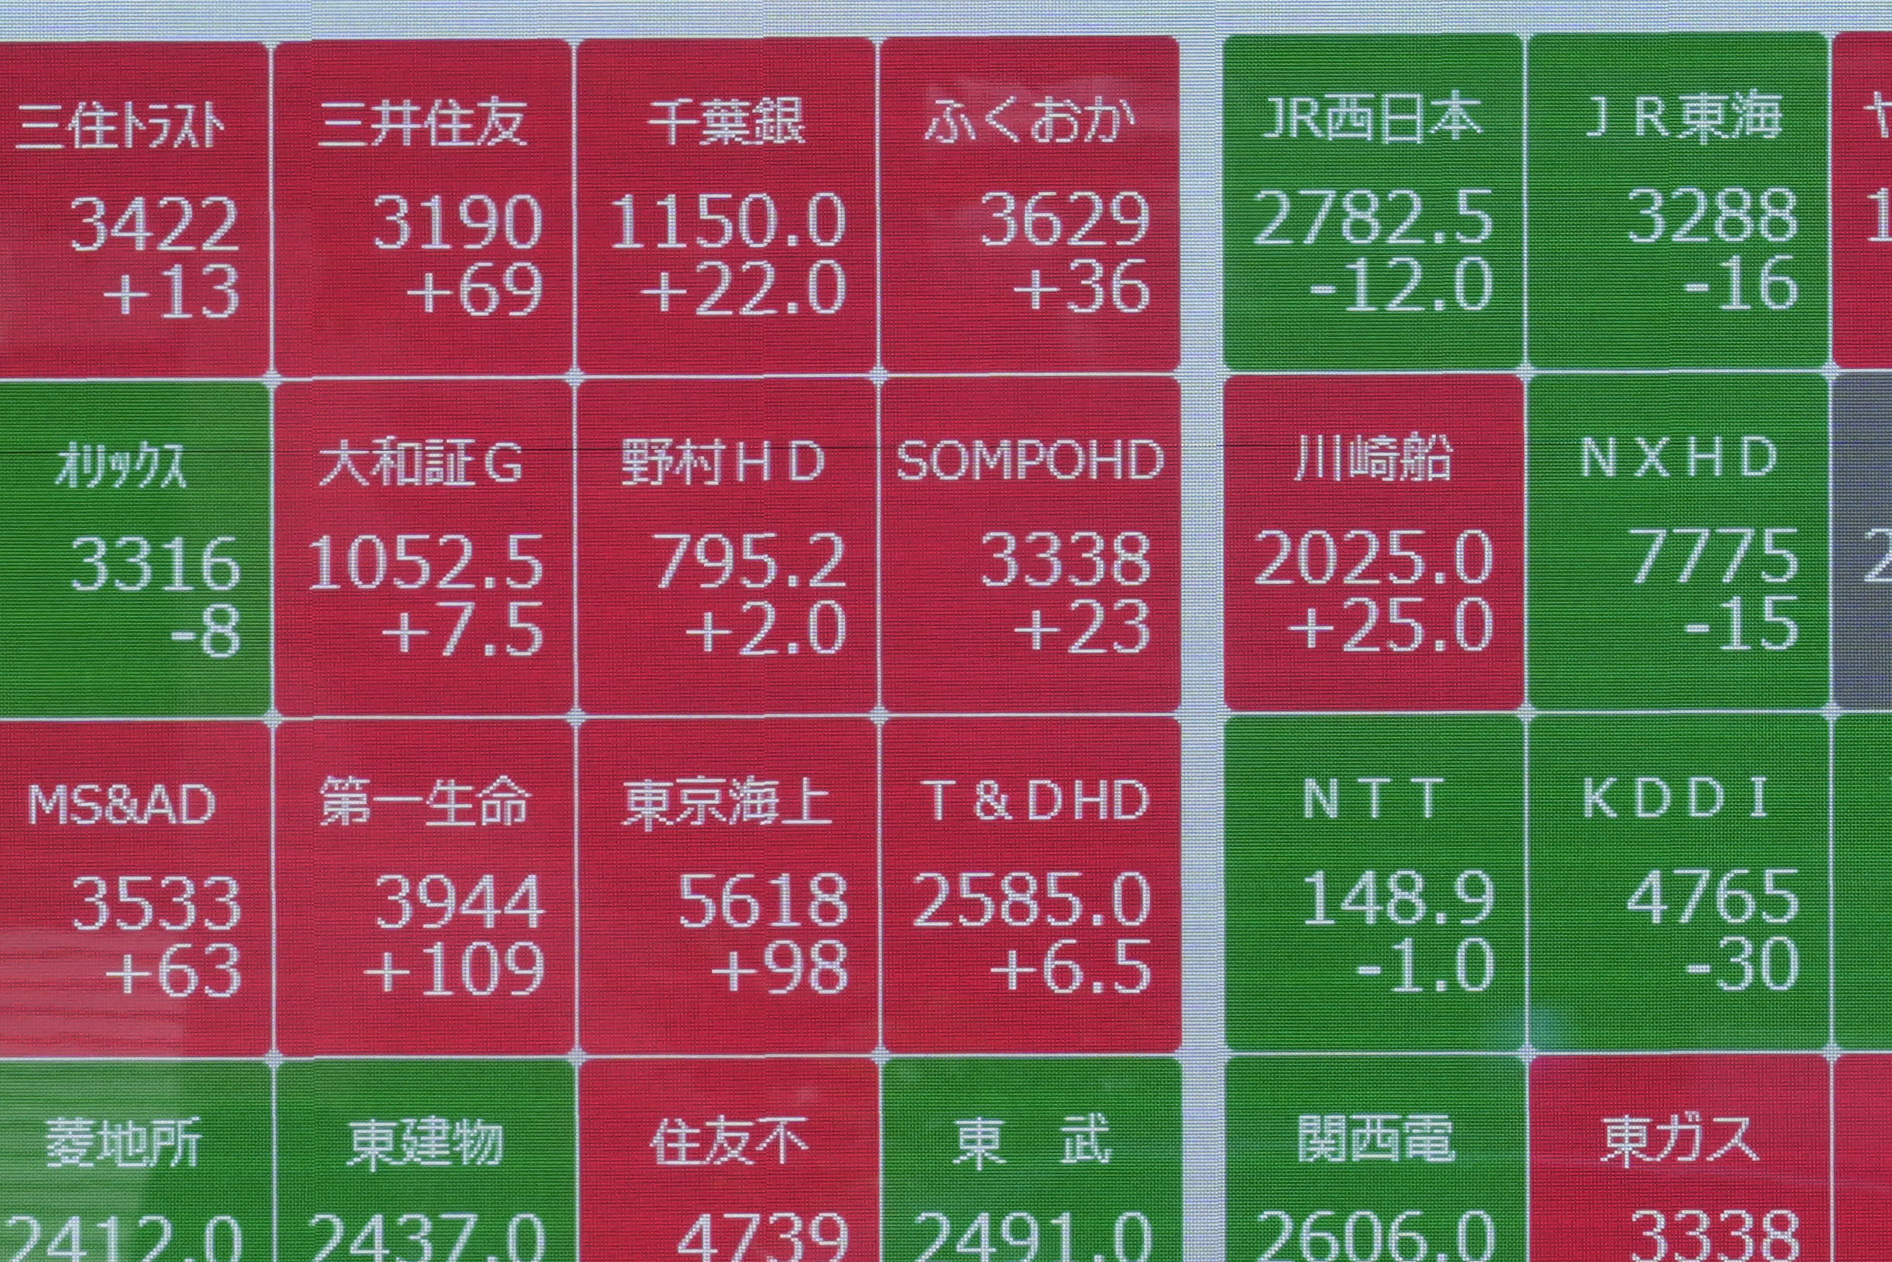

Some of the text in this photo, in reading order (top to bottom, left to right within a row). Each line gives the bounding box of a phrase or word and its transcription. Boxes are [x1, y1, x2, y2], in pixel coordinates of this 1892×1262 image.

[316, 94, 528, 150] 三井住友
[646, 94, 807, 148] 千葉銀
[921, 94, 1137, 147] ふくおか
[1263, 89, 1484, 145] JR西日本
[68, 194, 241, 254] 3422
[371, 191, 545, 252] 3190
[610, 189, 848, 252] 1150.0
[978, 189, 1151, 249] 3629
[1252, 186, 1495, 247] 2782.5
[1626, 185, 1800, 245] 3288
[101, 260, 242, 321] +13
[404, 259, 545, 319] +69
[639, 256, 849, 319] +22.0
[1011, 256, 1152, 316] +36
[1308, 254, 1495, 314] -12.0
[1682, 252, 1800, 312] -16
[317, 433, 524, 489] 大和証G
[895, 436, 1167, 484] SOMPOHD
[1292, 429, 1455, 484] 川崎船
[69, 534, 243, 594] 3316
[309, 531, 545, 592] 1052.5
[651, 529, 848, 591] 795.2
[978, 529, 1153, 589] 3338
[1252, 527, 1495, 588] 2025.0
[1628, 525, 1799, 586] 7775
[380, 598, 545, 659] +7.5
[683, 597, 849, 659] +2.0
[1012, 596, 1152, 657] +23
[1287, 594, 1495, 655] +25.0
[1683, 593, 1799, 653] -15
[26, 781, 218, 828] MS&AD
[317, 772, 532, 829] 第一生命
[620, 773, 834, 834] 東京海上
[71, 873, 244, 933] 3533
[373, 871, 546, 932] 3944
[677, 870, 851, 931] 5618
[910, 869, 1153, 930] 2585.0
[1302, 867, 1496, 928] 148.9
[1624, 866, 1801, 926] 4765
[103, 940, 243, 1000] +63
[362, 938, 547, 999] +109
[709, 936, 851, 997] +98
[988, 936, 1153, 996] +6.5
[1354, 935, 1497, 995] -1.0
[1684, 933, 1801, 993] -30
[45, 1115, 201, 1170] 菱地所
[345, 1113, 505, 1174] 東建物
[647, 1112, 809, 1169] 住友不
[1295, 1111, 1458, 1165] 関西電
[1598, 1109, 1761, 1171] 東ガス
